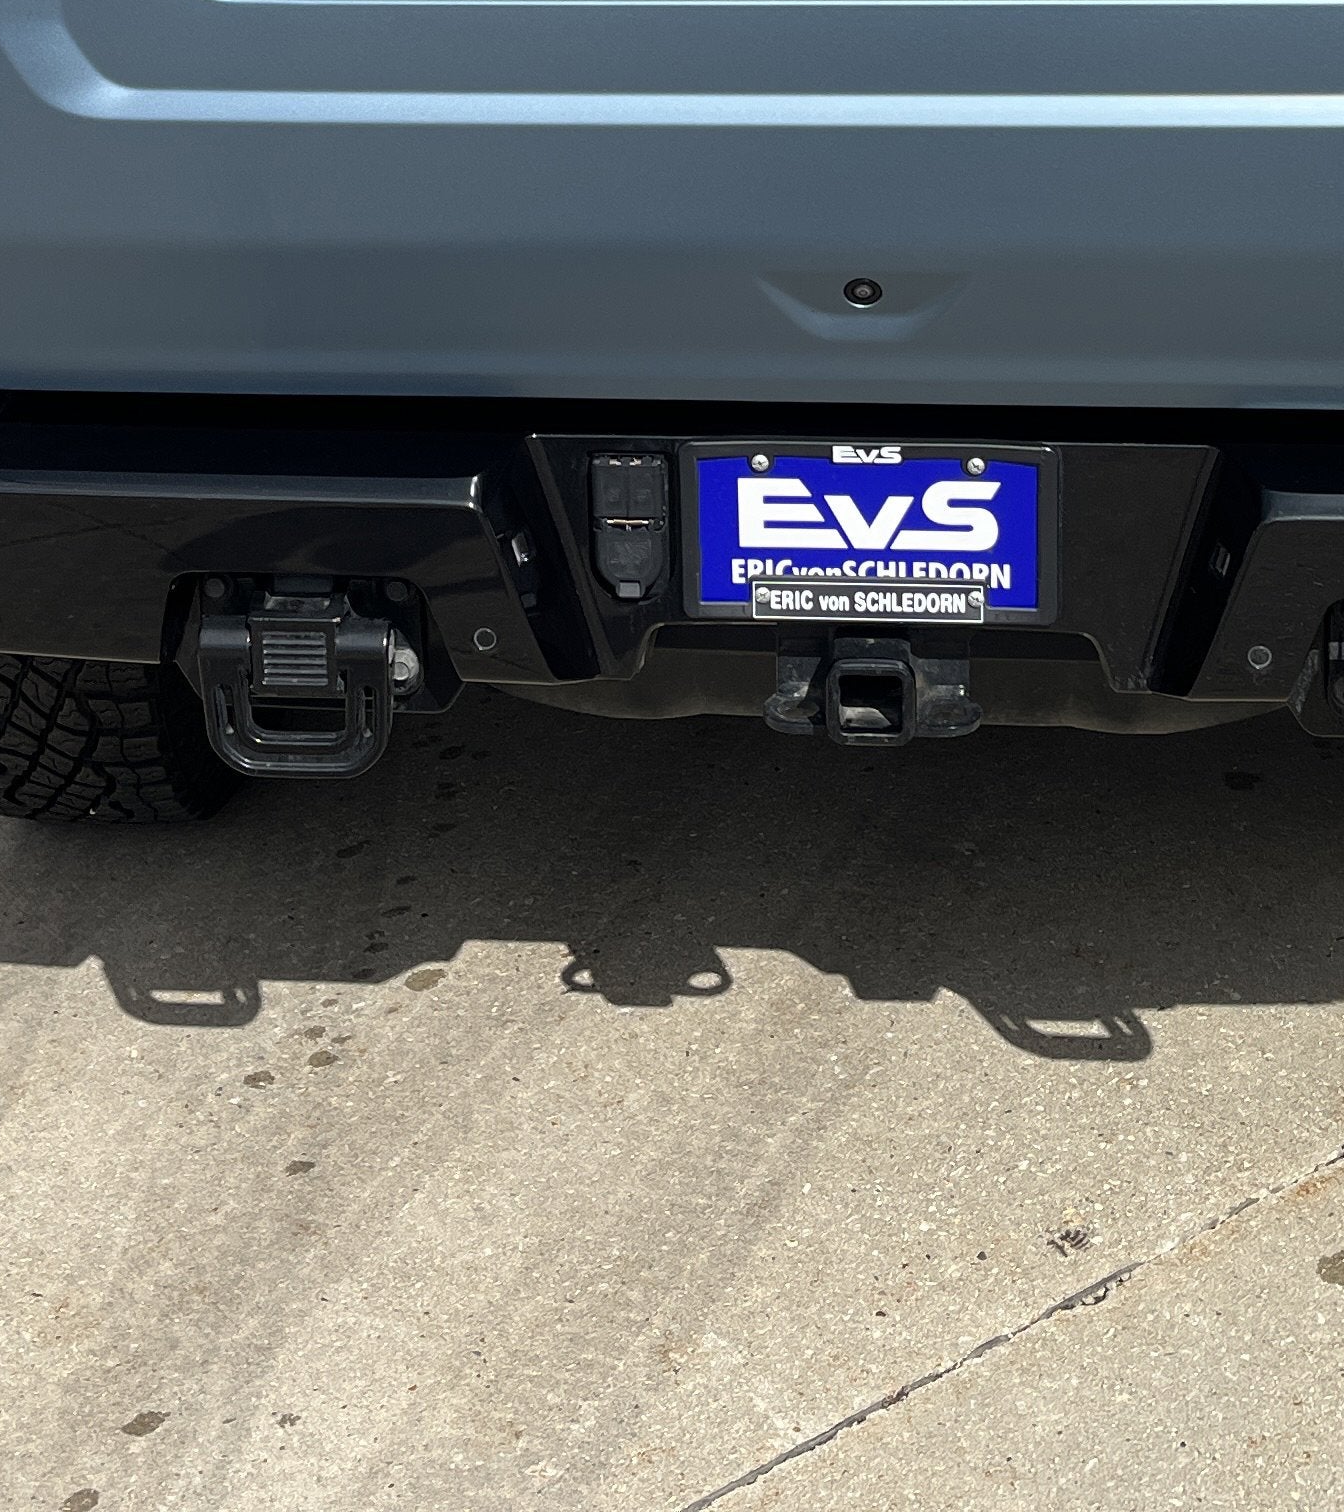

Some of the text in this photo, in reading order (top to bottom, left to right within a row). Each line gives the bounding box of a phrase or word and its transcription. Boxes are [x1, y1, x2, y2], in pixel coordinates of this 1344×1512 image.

[769, 589, 967, 614] ERIC von SCHLEDORN
